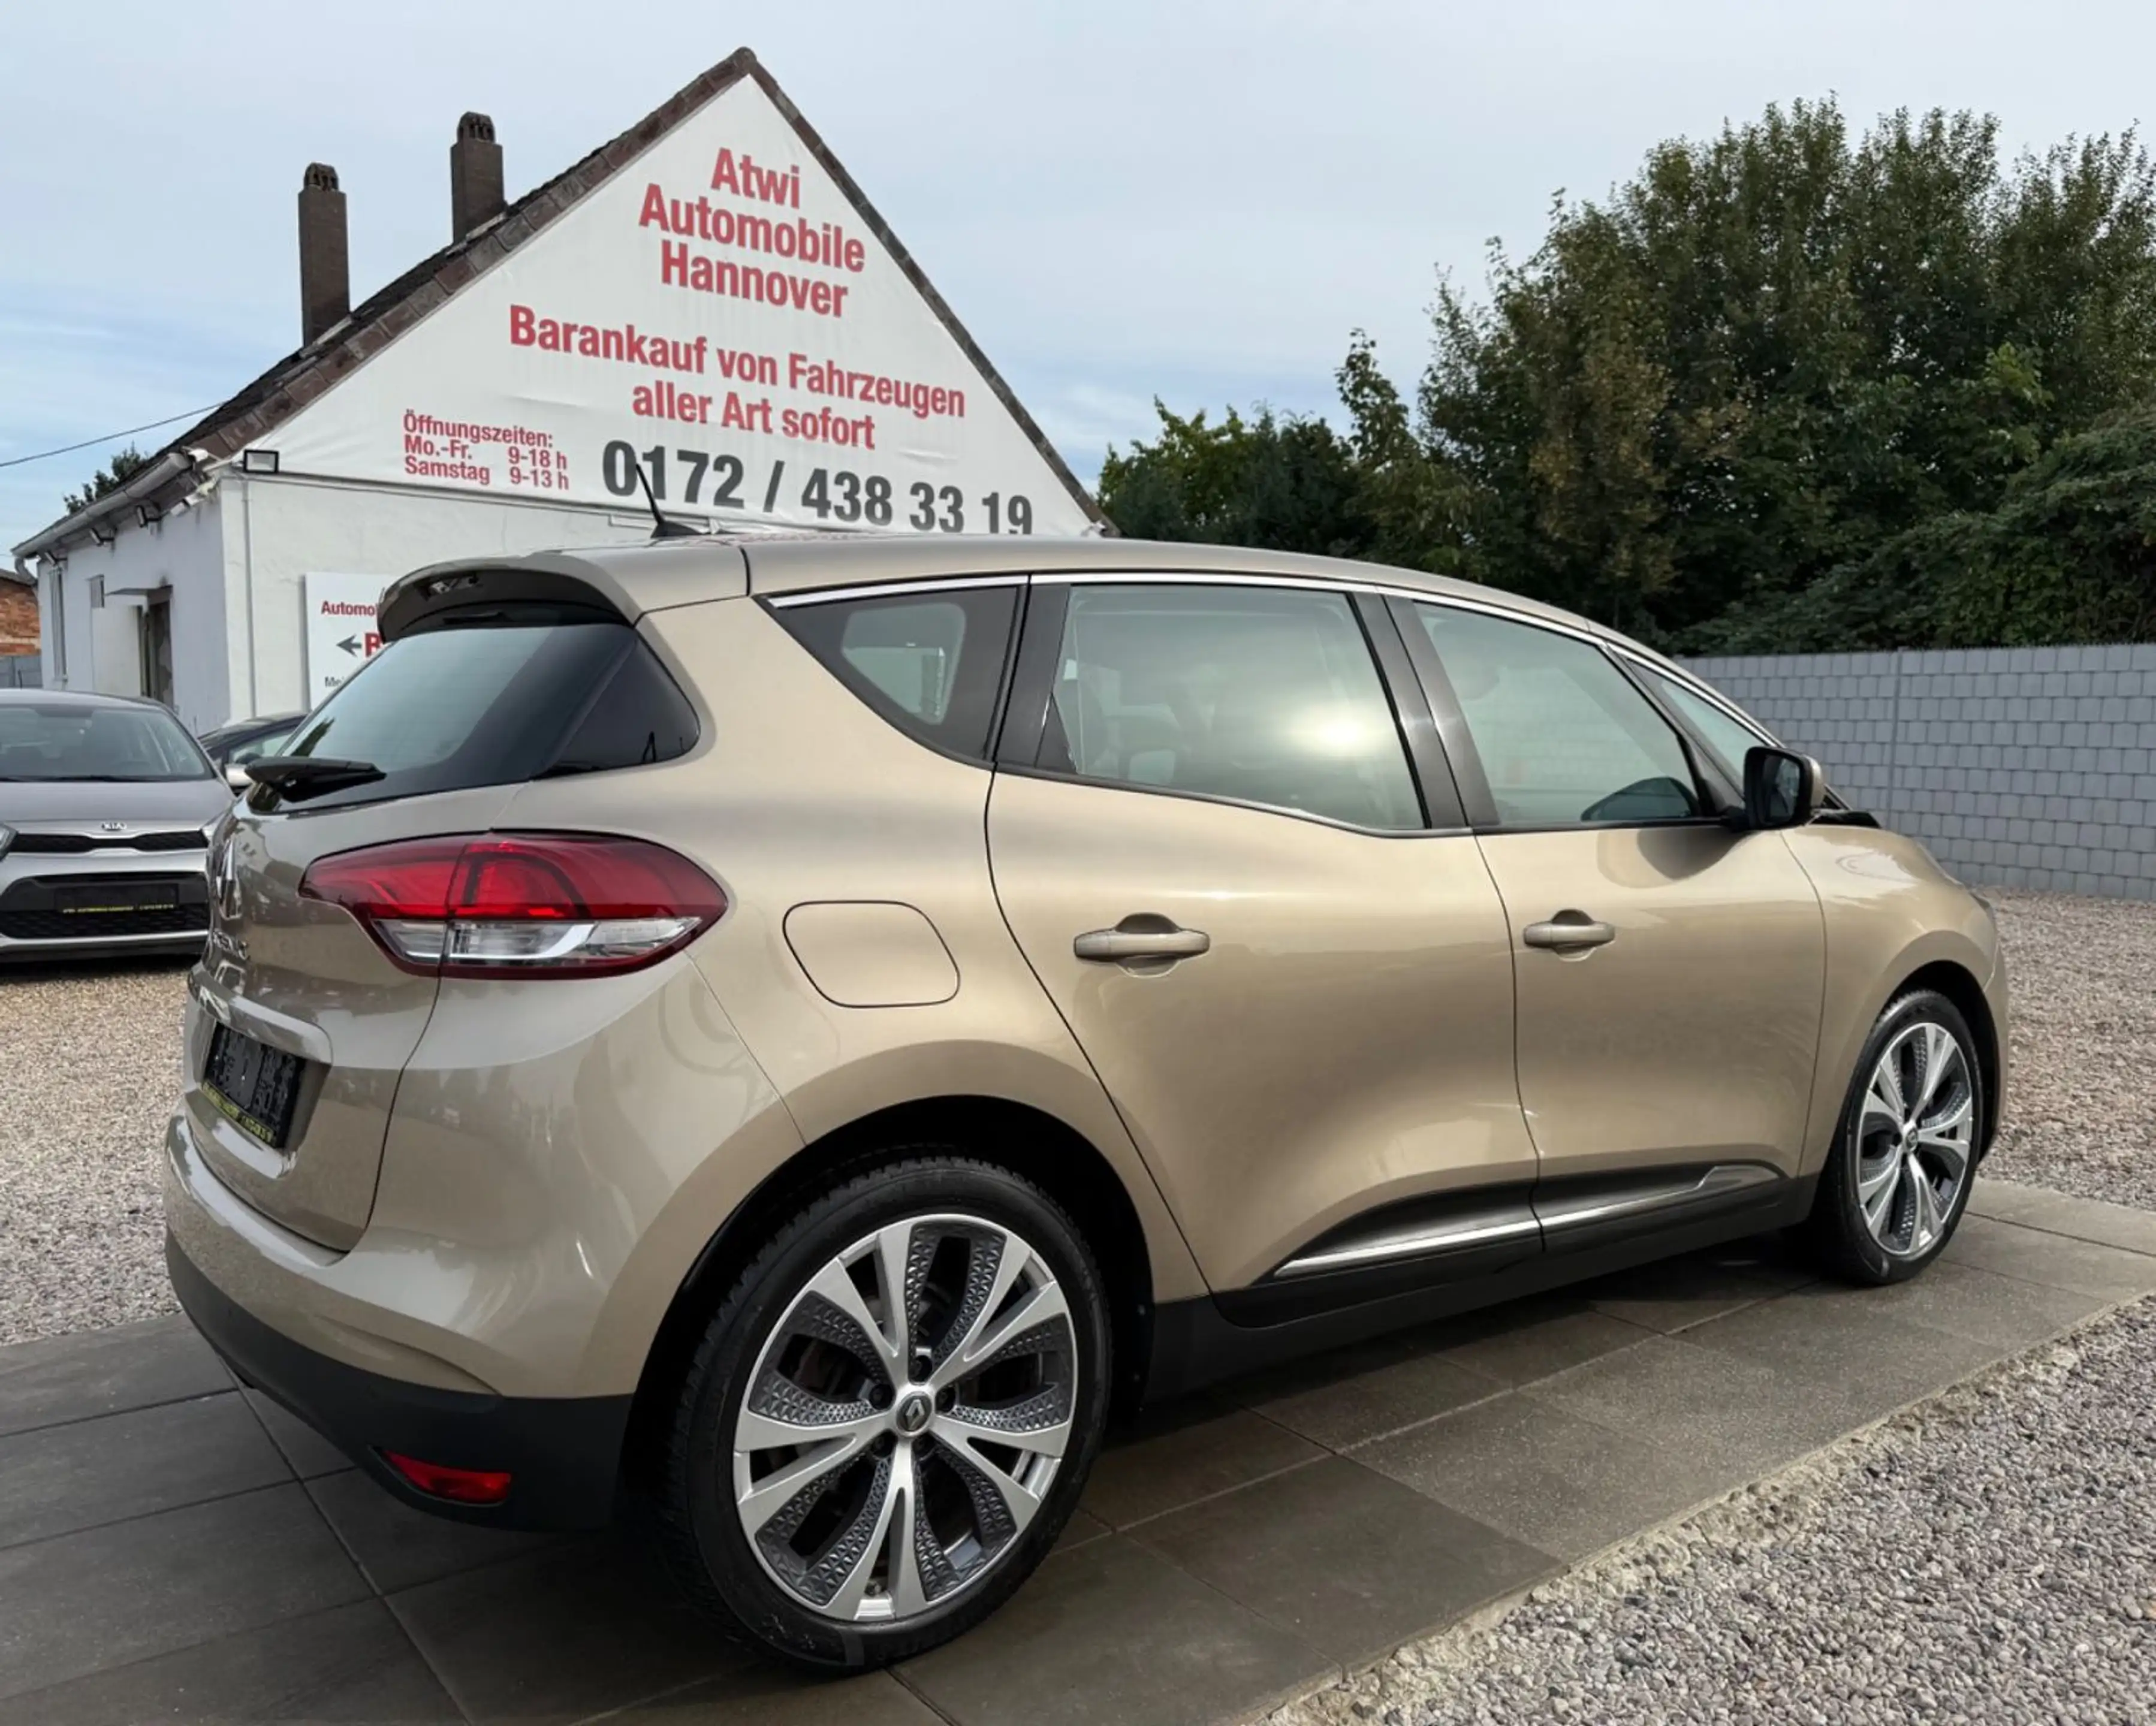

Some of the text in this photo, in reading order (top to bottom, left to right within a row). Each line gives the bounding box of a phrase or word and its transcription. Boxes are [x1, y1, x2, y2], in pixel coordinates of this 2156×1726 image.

[711, 147, 800, 209] Atwi
[639, 183, 866, 273] Automobile
[661, 239, 848, 318] Hannover
[509, 304, 966, 420] Barankauf von Fahrzeugen
[404, 409, 553, 448] Öffnungszeiten:
[632, 380, 875, 451] aller Art sofort
[405, 434, 568, 470] Mo.-Fr. 9-18 h
[405, 455, 569, 490] Samstag 9-13 h
[603, 440, 1032, 535] 0172 / 438 33 19
